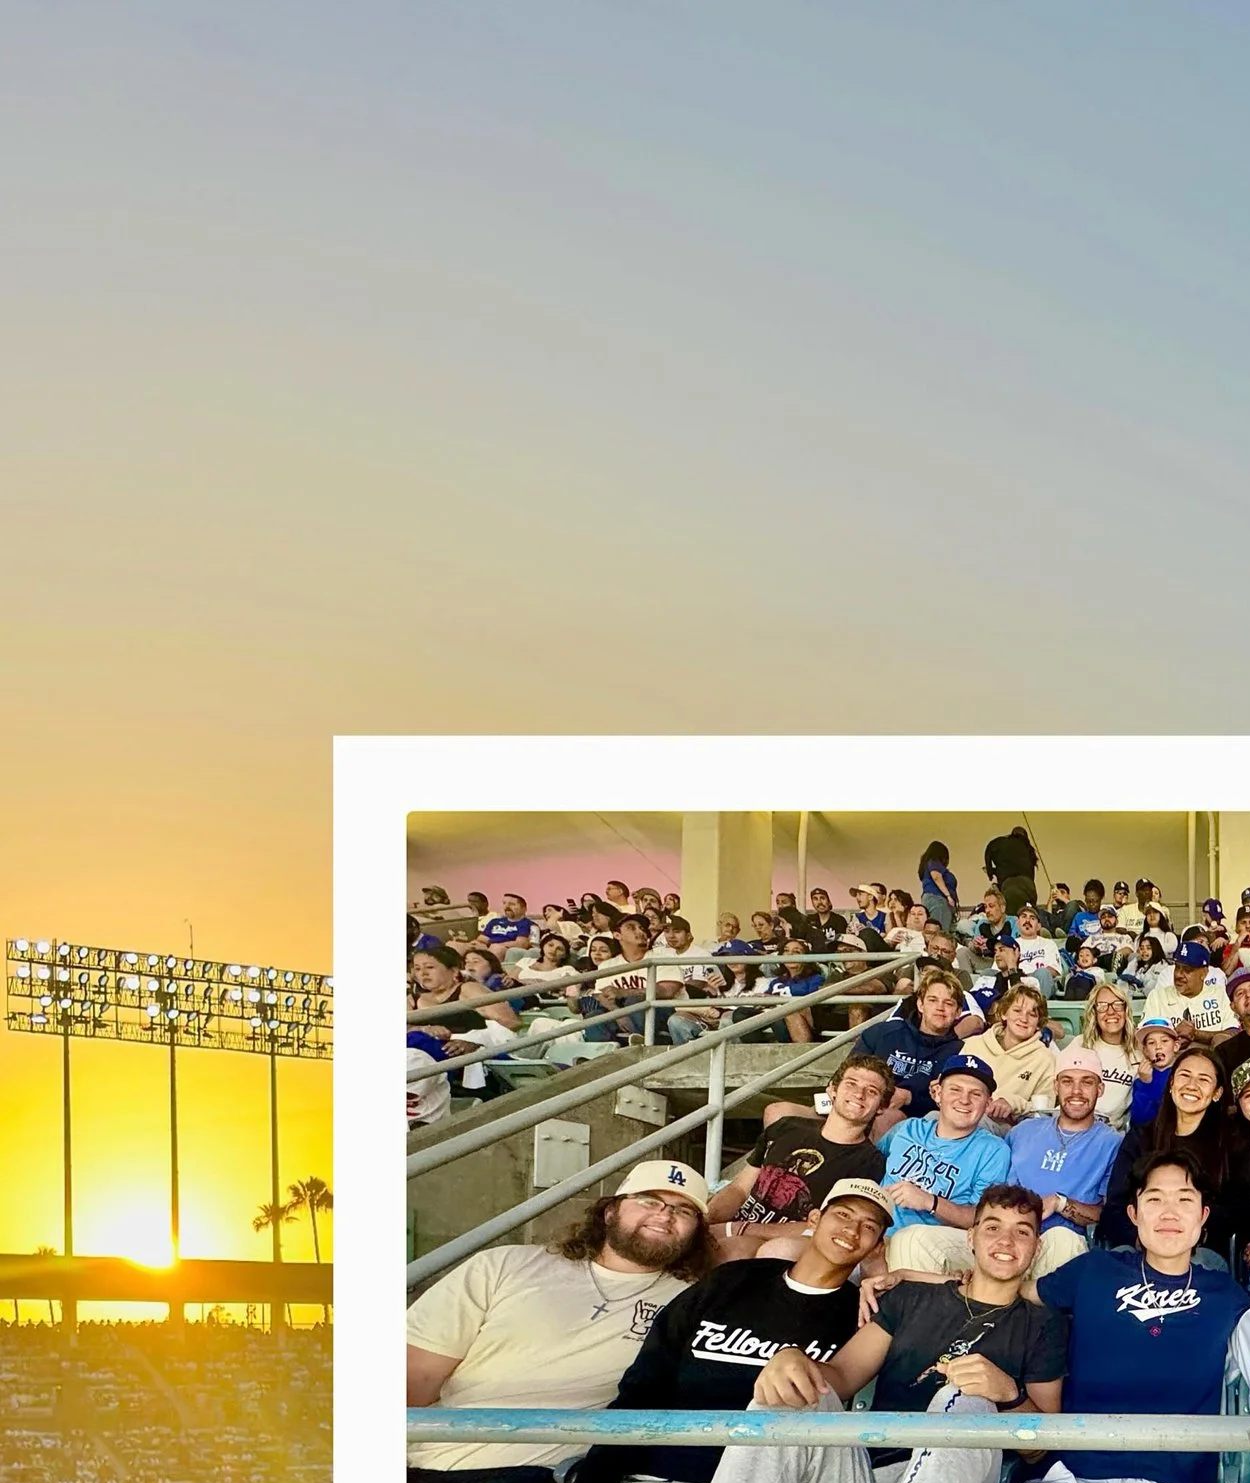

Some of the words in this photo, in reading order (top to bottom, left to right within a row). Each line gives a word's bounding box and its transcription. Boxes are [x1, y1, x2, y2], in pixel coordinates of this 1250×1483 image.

[1203, 1000, 1219, 1010] 05
[965, 1055, 978, 1069] LA
[667, 1165, 686, 1187] LA
[850, 1183, 888, 1203] HORIZON
[1116, 1283, 1201, 1313] Korea
[691, 1320, 837, 1364] Fellowhi
